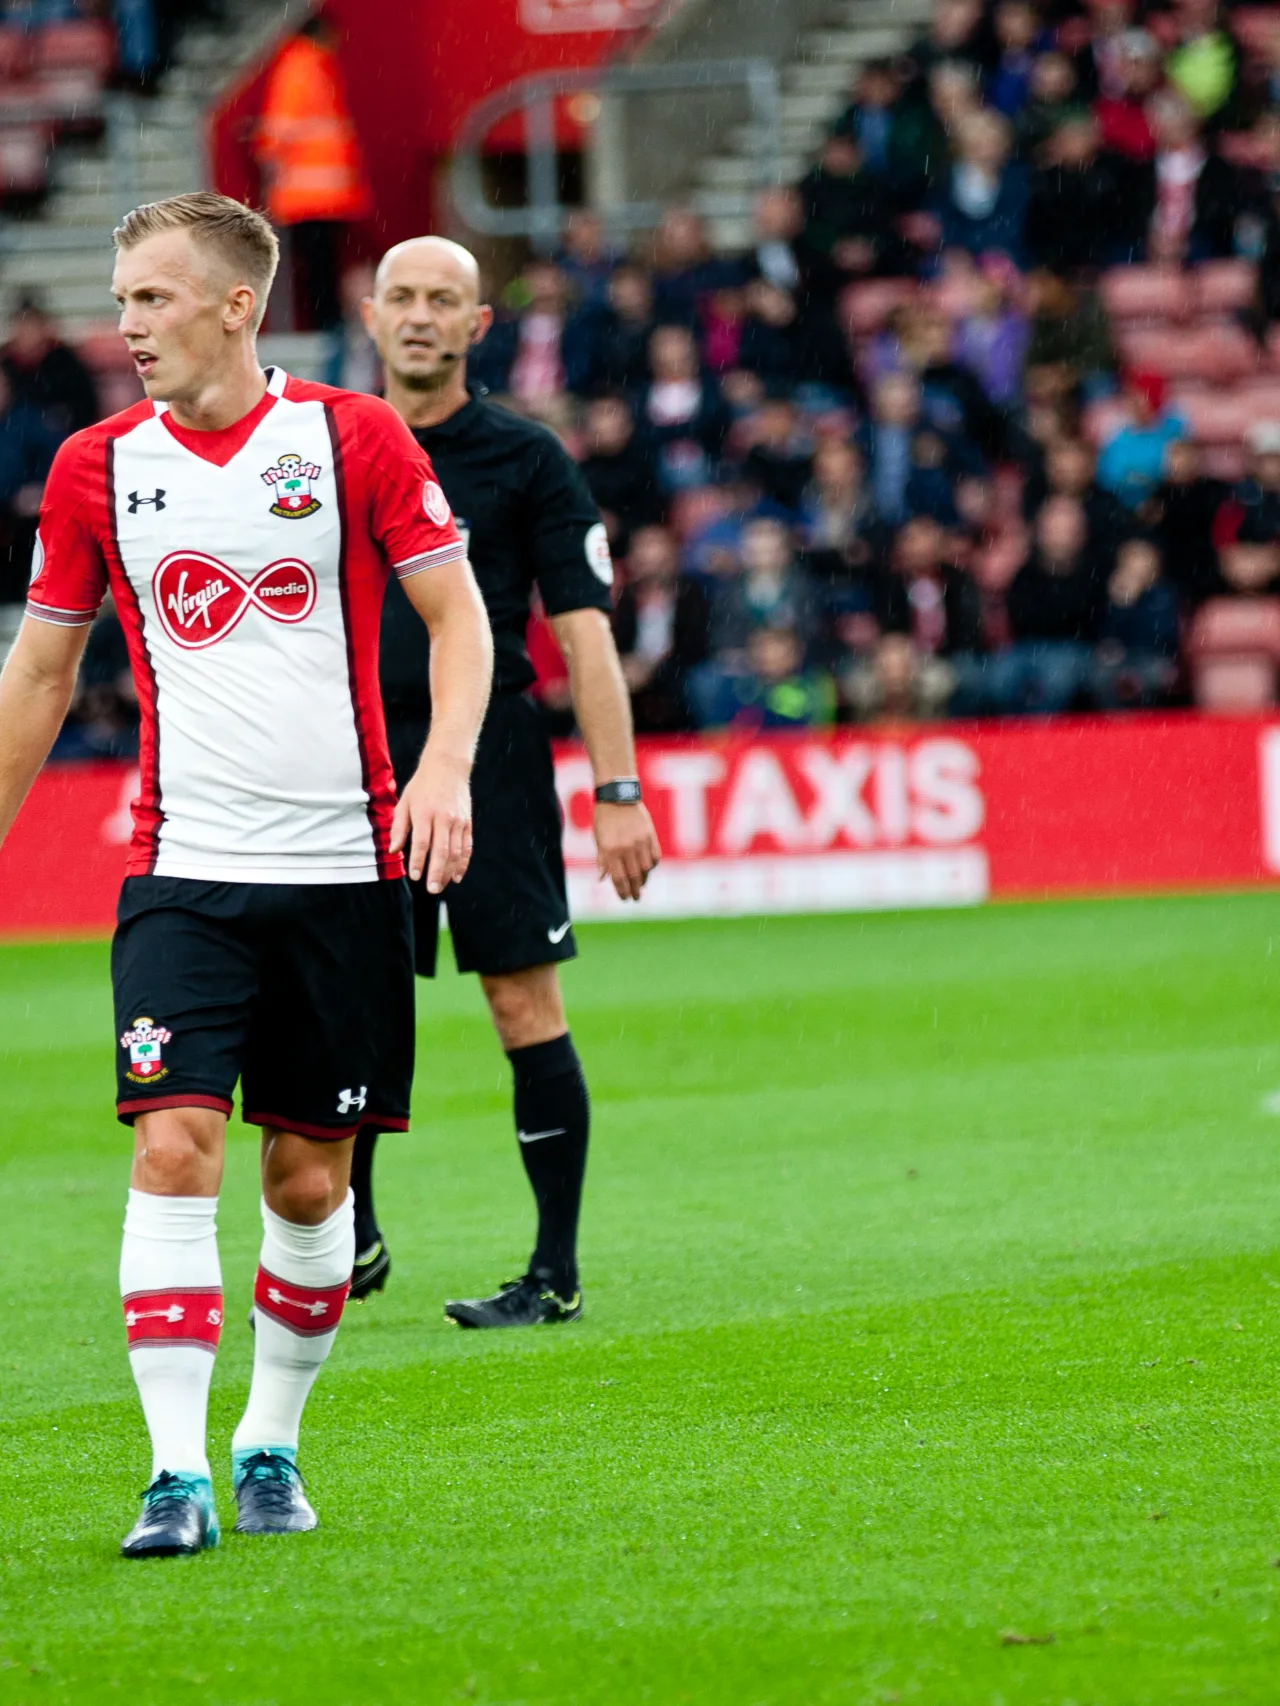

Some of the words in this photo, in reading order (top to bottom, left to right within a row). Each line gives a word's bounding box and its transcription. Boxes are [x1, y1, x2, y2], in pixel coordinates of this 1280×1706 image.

[167, 571, 231, 629] Virgin
[259, 582, 307, 598] media
[648, 738, 986, 857] TAXIS
